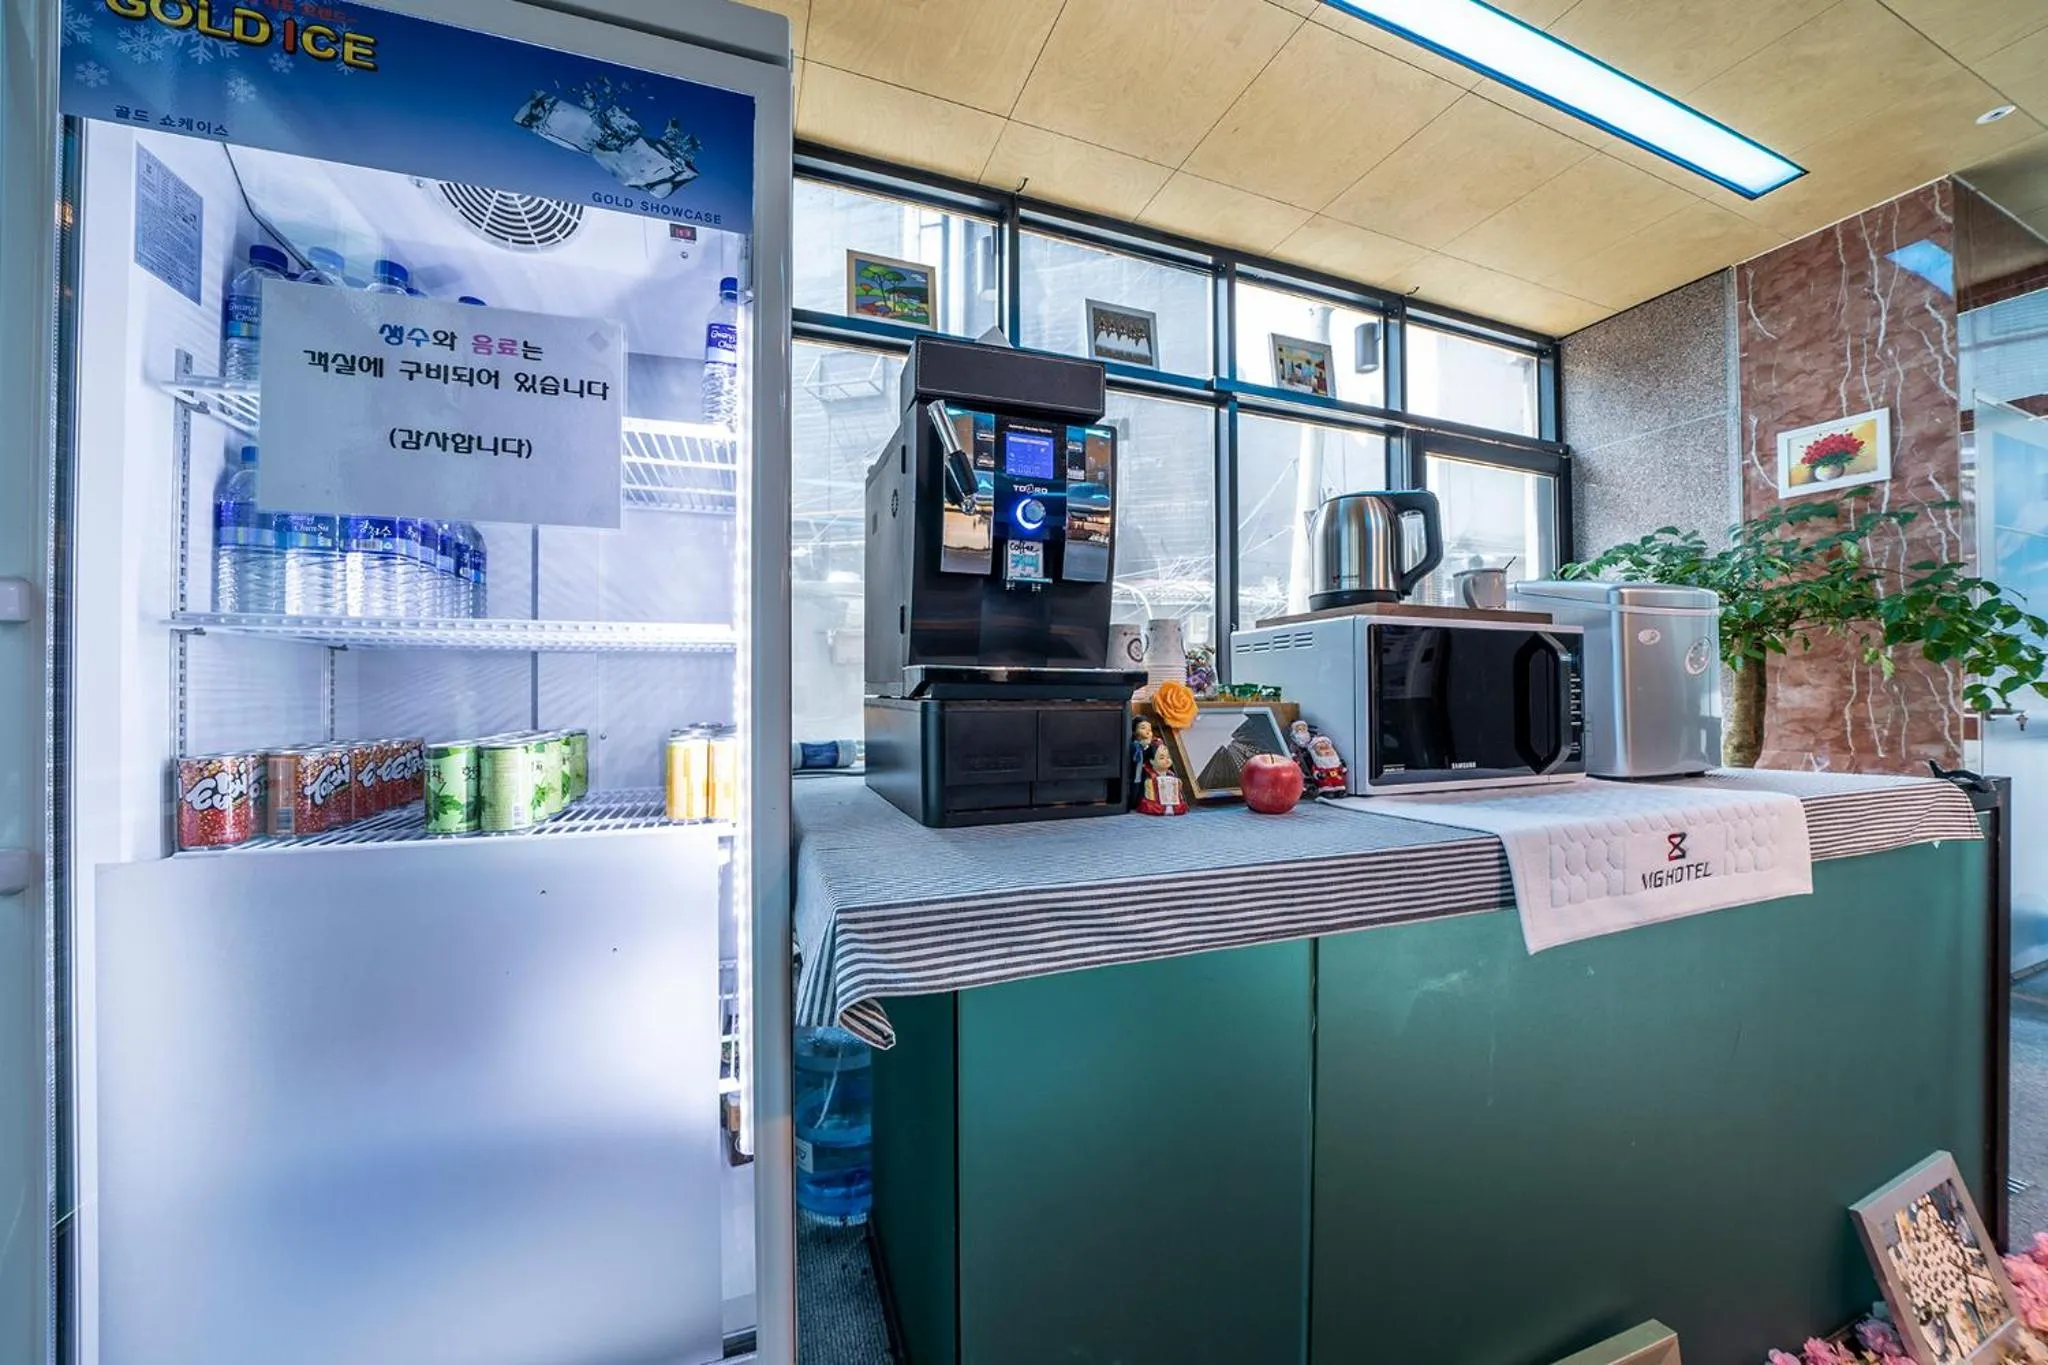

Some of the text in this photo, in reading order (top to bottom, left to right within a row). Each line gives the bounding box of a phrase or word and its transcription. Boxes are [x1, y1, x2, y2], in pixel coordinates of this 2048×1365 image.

[283, 19, 377, 70] ICE
[112, 104, 229, 137] 골드 쇼케이스
[592, 192, 721, 225] GOLD SHOWCASE
[379, 323, 543, 362] 생수와 음료는
[303, 350, 610, 400] 객실에 구비되어 있습니다
[389, 428, 532, 459] (감사합니다)
